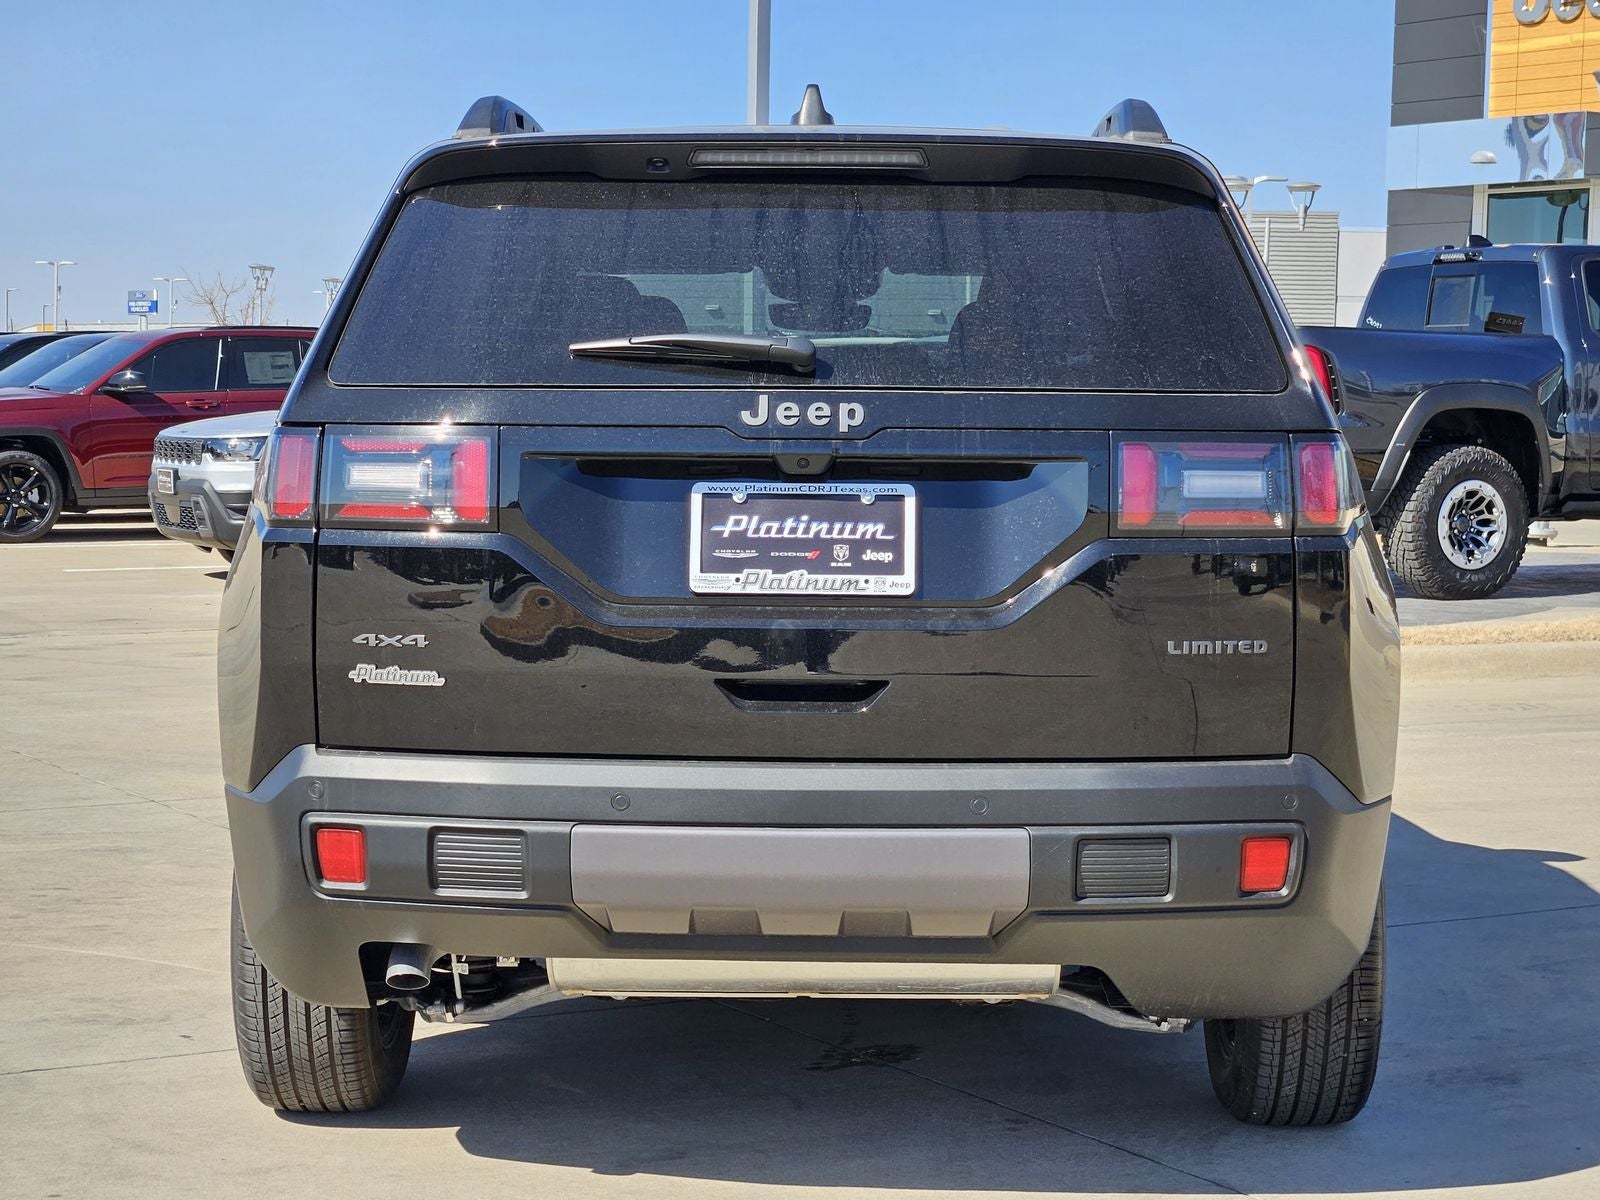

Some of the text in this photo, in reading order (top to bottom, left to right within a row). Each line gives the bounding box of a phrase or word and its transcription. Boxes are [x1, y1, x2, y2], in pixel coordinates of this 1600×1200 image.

[741, 394, 865, 433] Jeep
[707, 484, 898, 494] www.PlatinumCDRJTexas.com
[710, 515, 897, 540] Platinum
[862, 549, 893, 563] Jeep
[735, 570, 870, 592] Platinum
[889, 580, 911, 590] Jeep
[1167, 640, 1269, 656] LIMITED
[348, 663, 446, 687] Platinum
